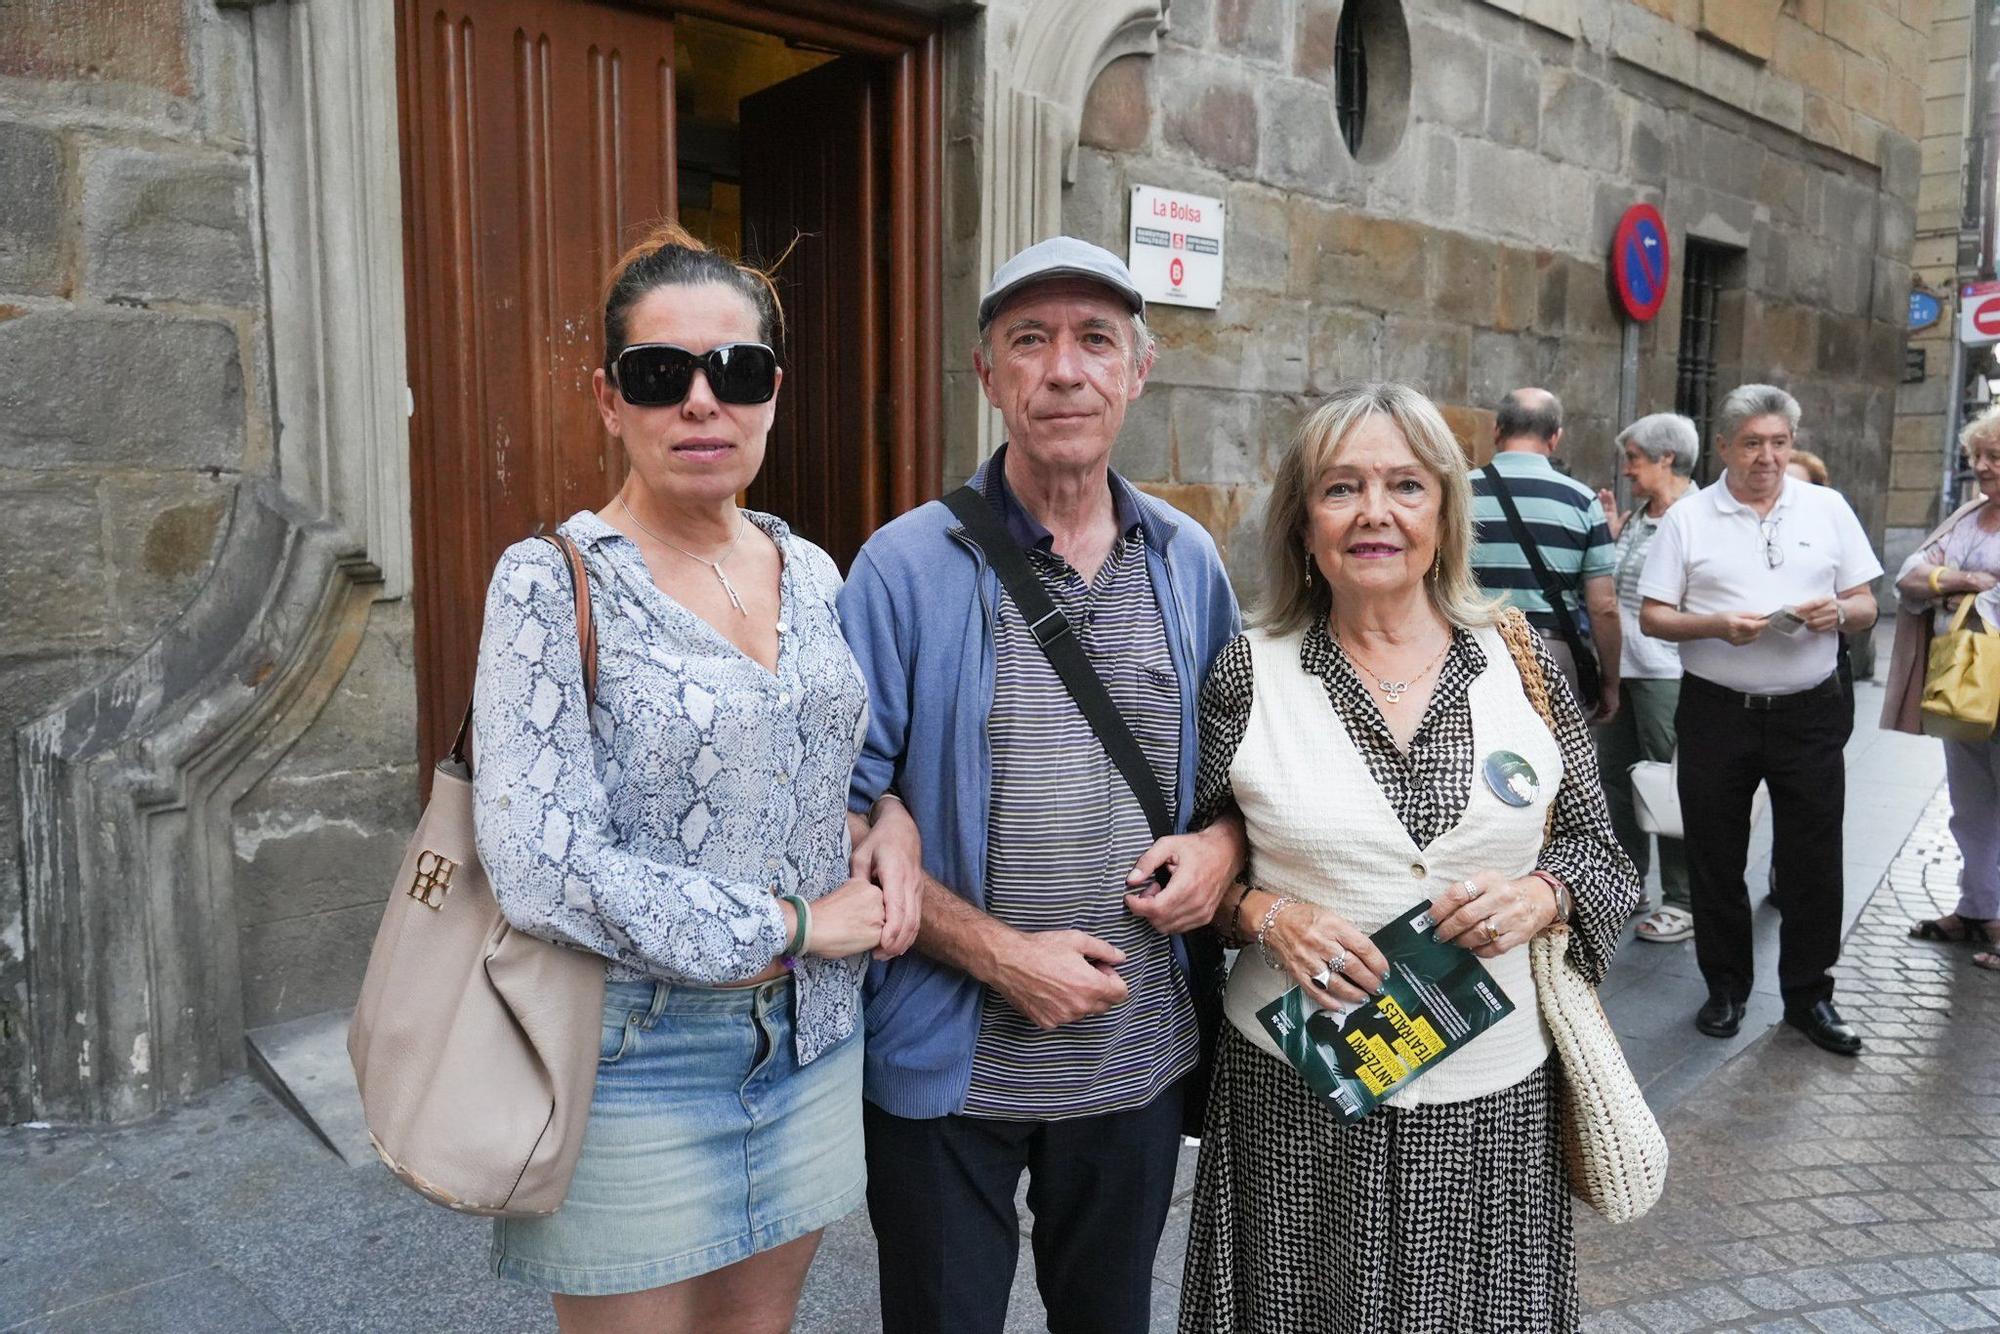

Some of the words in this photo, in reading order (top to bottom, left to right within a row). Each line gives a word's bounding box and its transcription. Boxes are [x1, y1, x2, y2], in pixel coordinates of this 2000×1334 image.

[1153, 198, 1166, 217] La
[1170, 202, 1201, 223] Bolsa
[1379, 1001, 1433, 1063] TEATRALES
[1349, 1036, 1396, 1089] ANTZERKI
